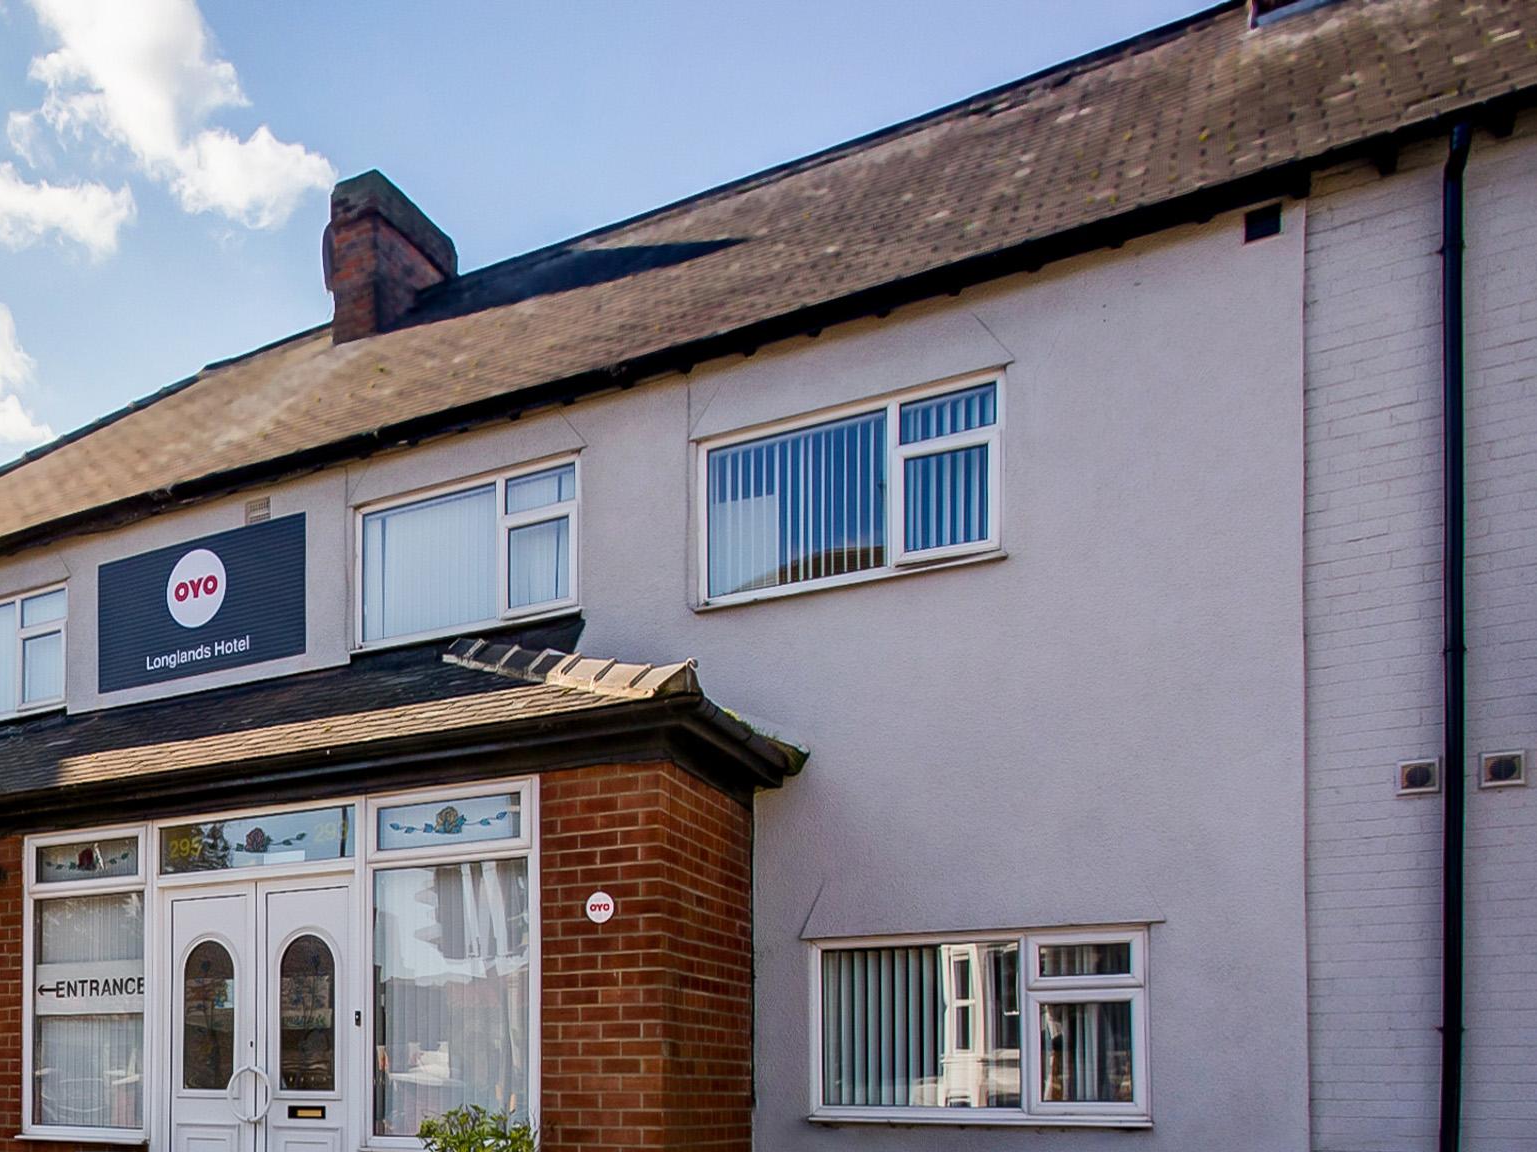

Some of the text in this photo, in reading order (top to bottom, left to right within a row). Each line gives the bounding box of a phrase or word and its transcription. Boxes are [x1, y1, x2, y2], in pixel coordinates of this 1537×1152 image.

[174, 575, 218, 602] OYO
[146, 635, 251, 670] Longlands Hotel
[56, 977, 144, 998] ENTRANCE
